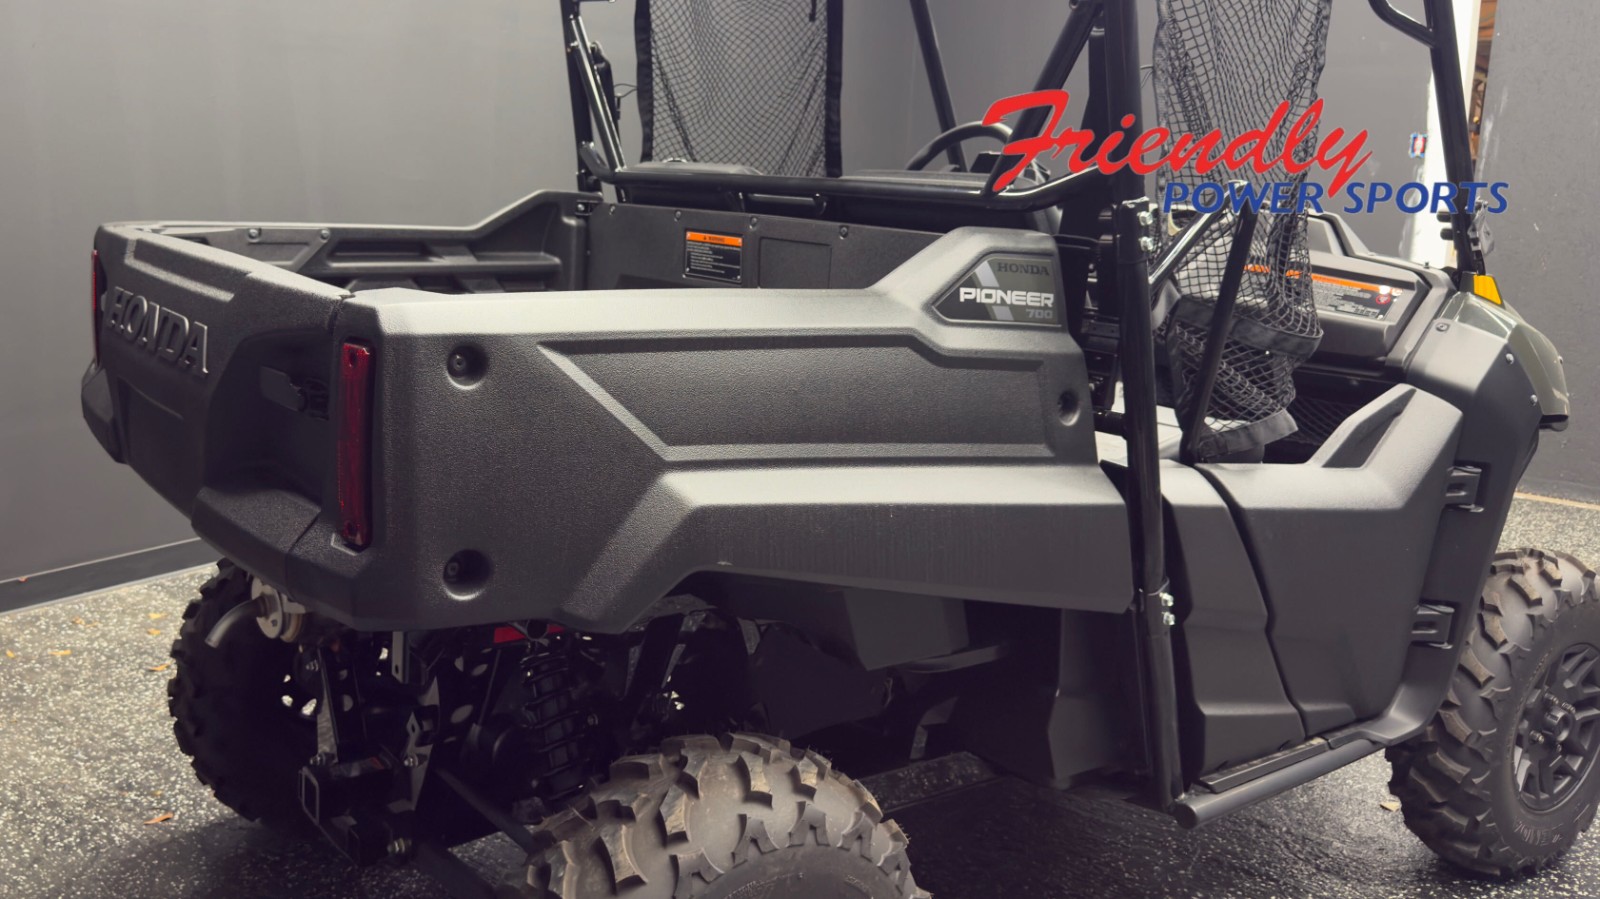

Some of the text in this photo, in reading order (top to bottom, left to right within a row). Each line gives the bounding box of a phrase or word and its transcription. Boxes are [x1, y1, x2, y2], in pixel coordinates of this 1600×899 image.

[997, 262, 1050, 276] HONDA
[959, 287, 1055, 307] PIONEER
[1026, 309, 1053, 319] 700
[107, 286, 209, 376] HONDA
